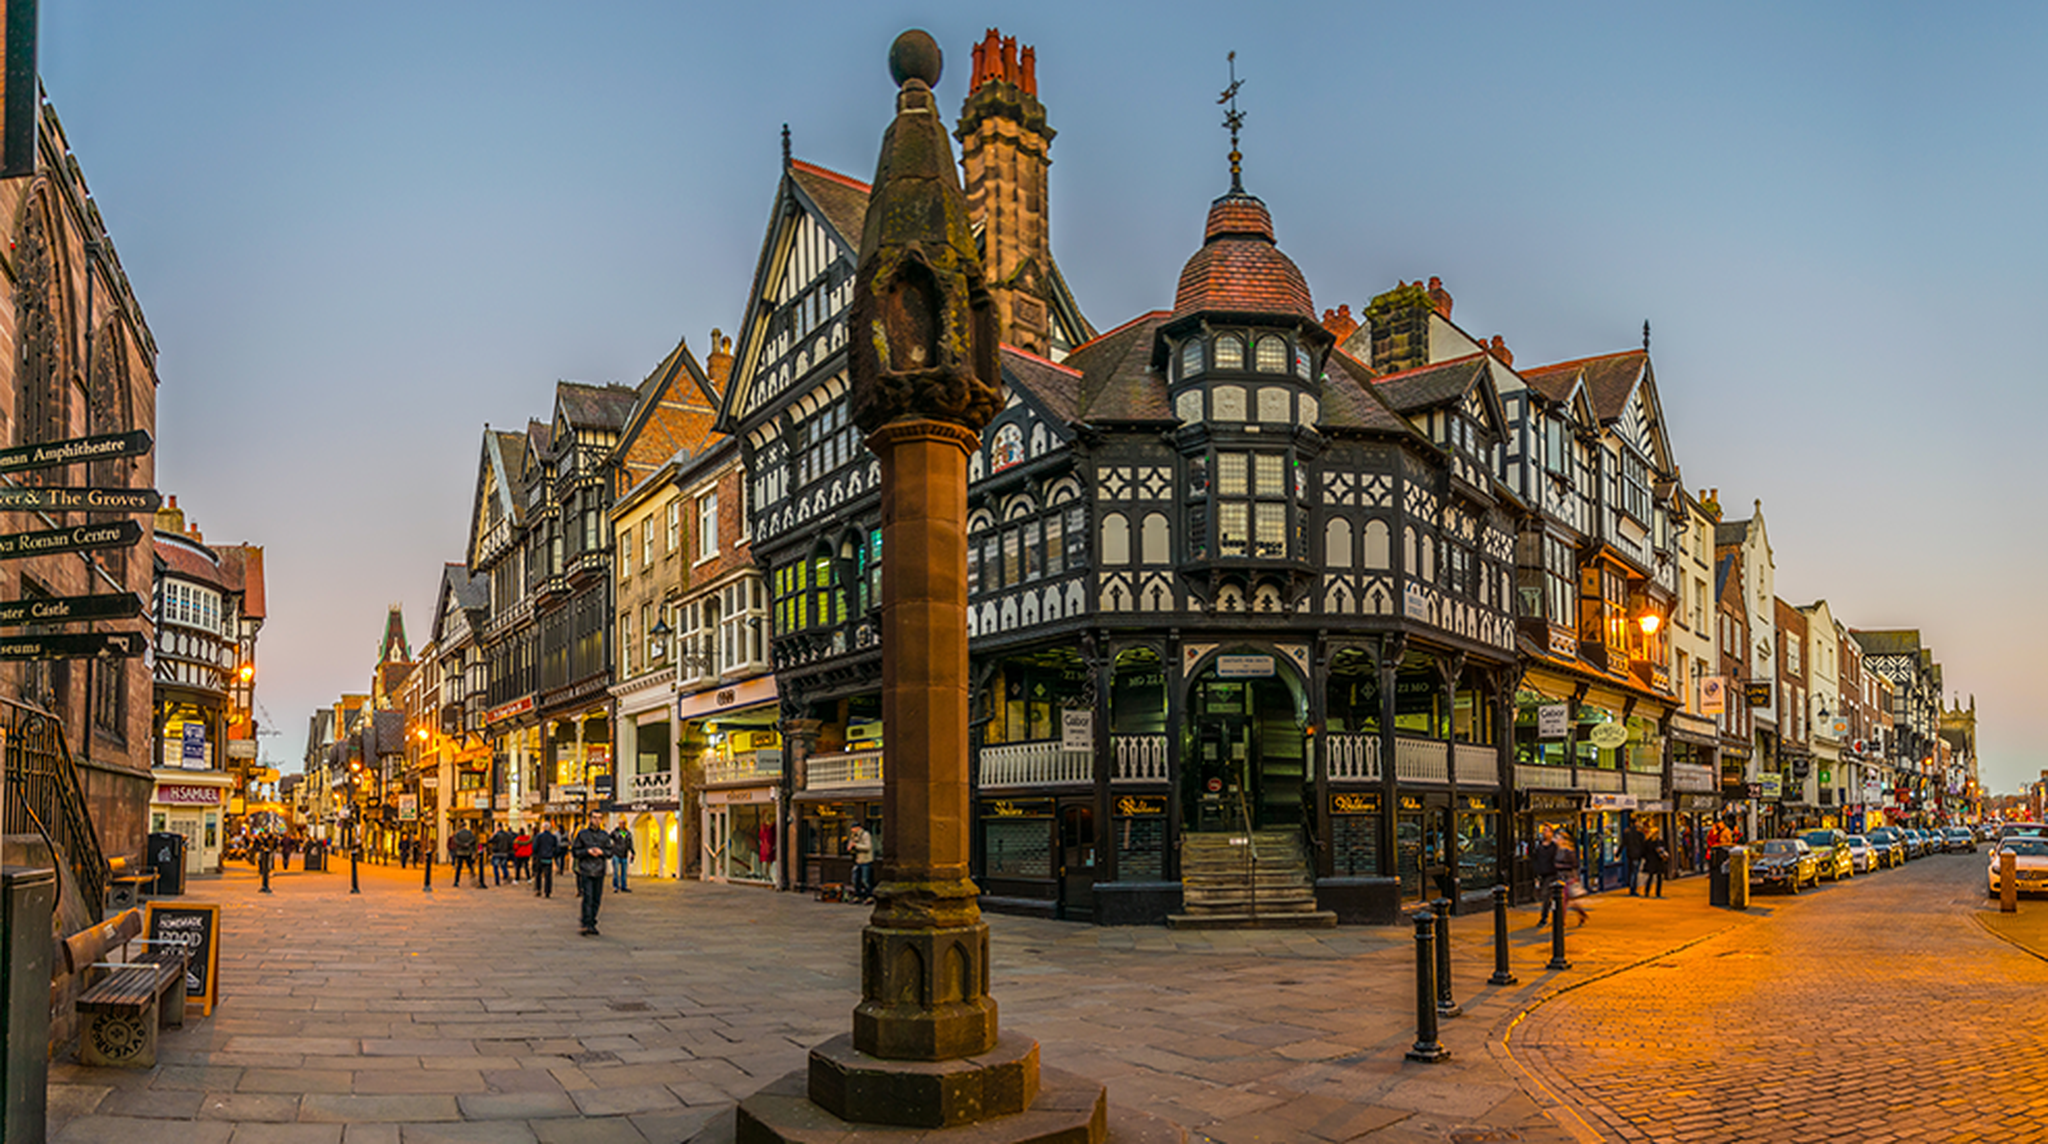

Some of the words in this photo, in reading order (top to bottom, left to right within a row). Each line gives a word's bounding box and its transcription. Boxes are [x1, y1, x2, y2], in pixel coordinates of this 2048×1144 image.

[33, 440, 126, 462] Amphitheatre
[24, 489, 41, 505] &
[46, 489, 82, 505] The
[88, 489, 147, 507] Groves
[19, 534, 69, 551] Roman
[72, 527, 121, 545] Centre
[31, 601, 71, 617] Castle
